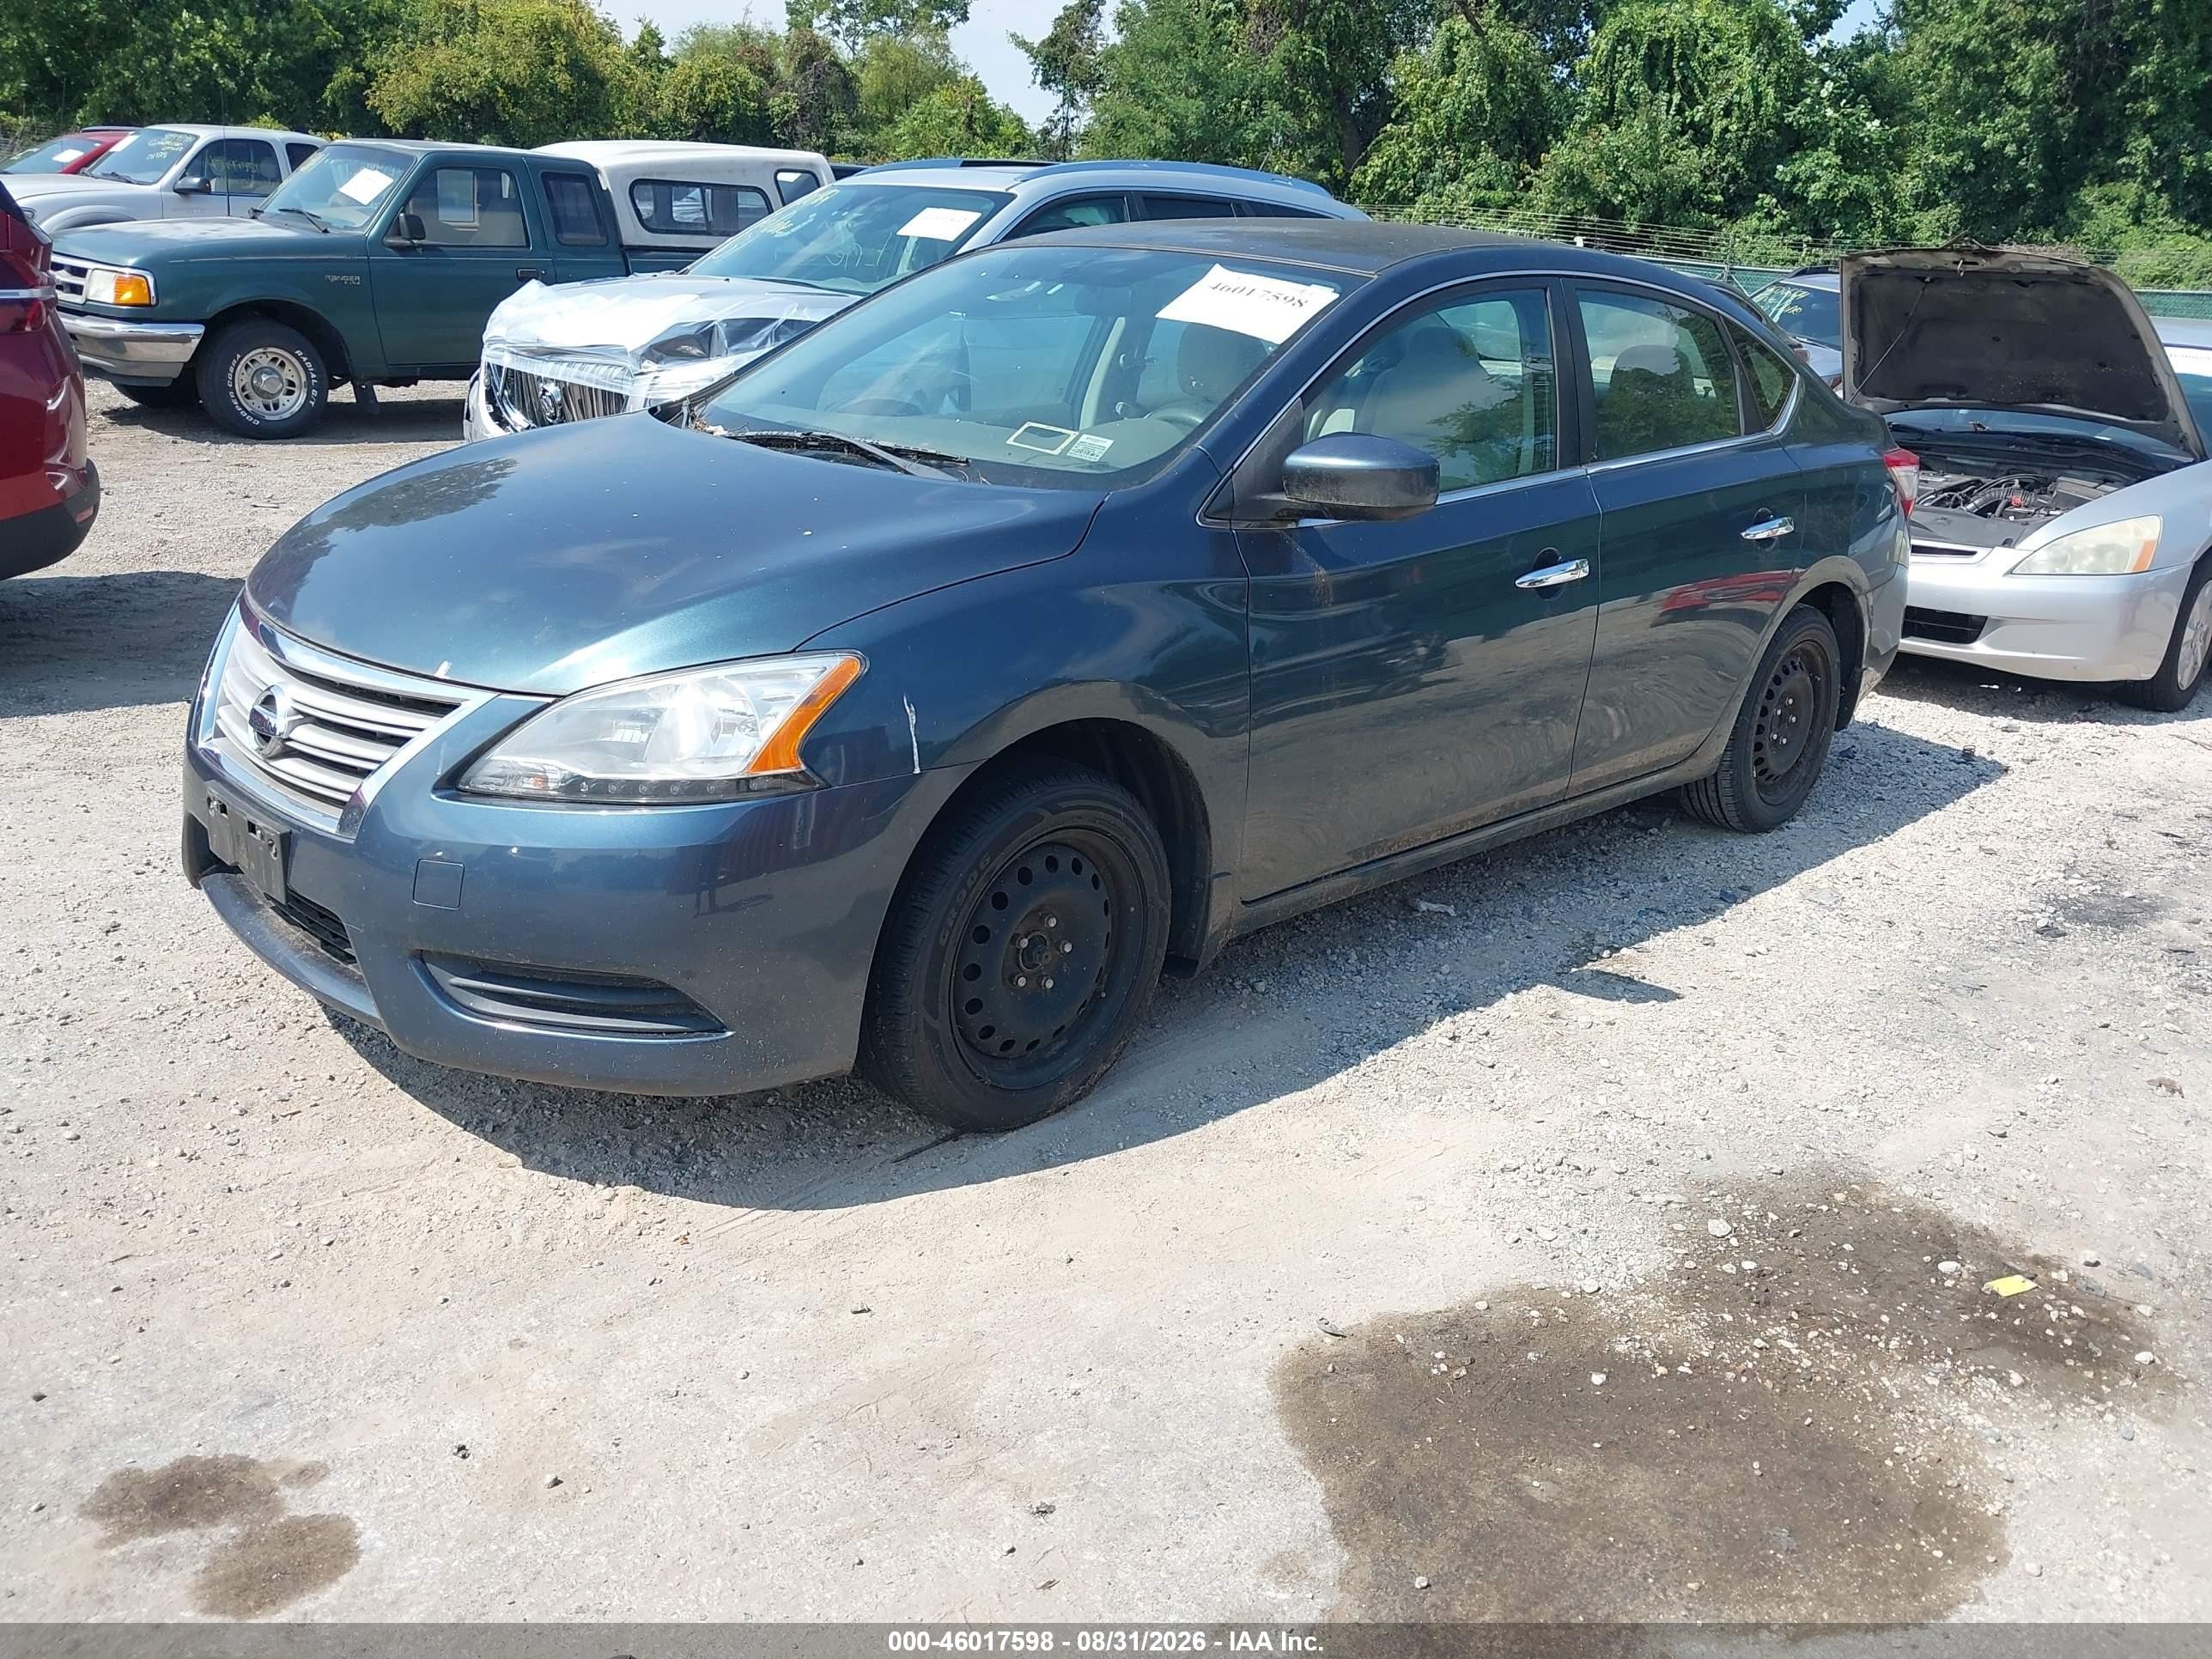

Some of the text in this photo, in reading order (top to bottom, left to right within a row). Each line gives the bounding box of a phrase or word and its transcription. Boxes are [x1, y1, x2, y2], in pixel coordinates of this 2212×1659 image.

[1209, 282, 1309, 308] 46017598
[294, 349, 319, 386] RADIAL
[227, 354, 261, 426] COOPER COBRA
